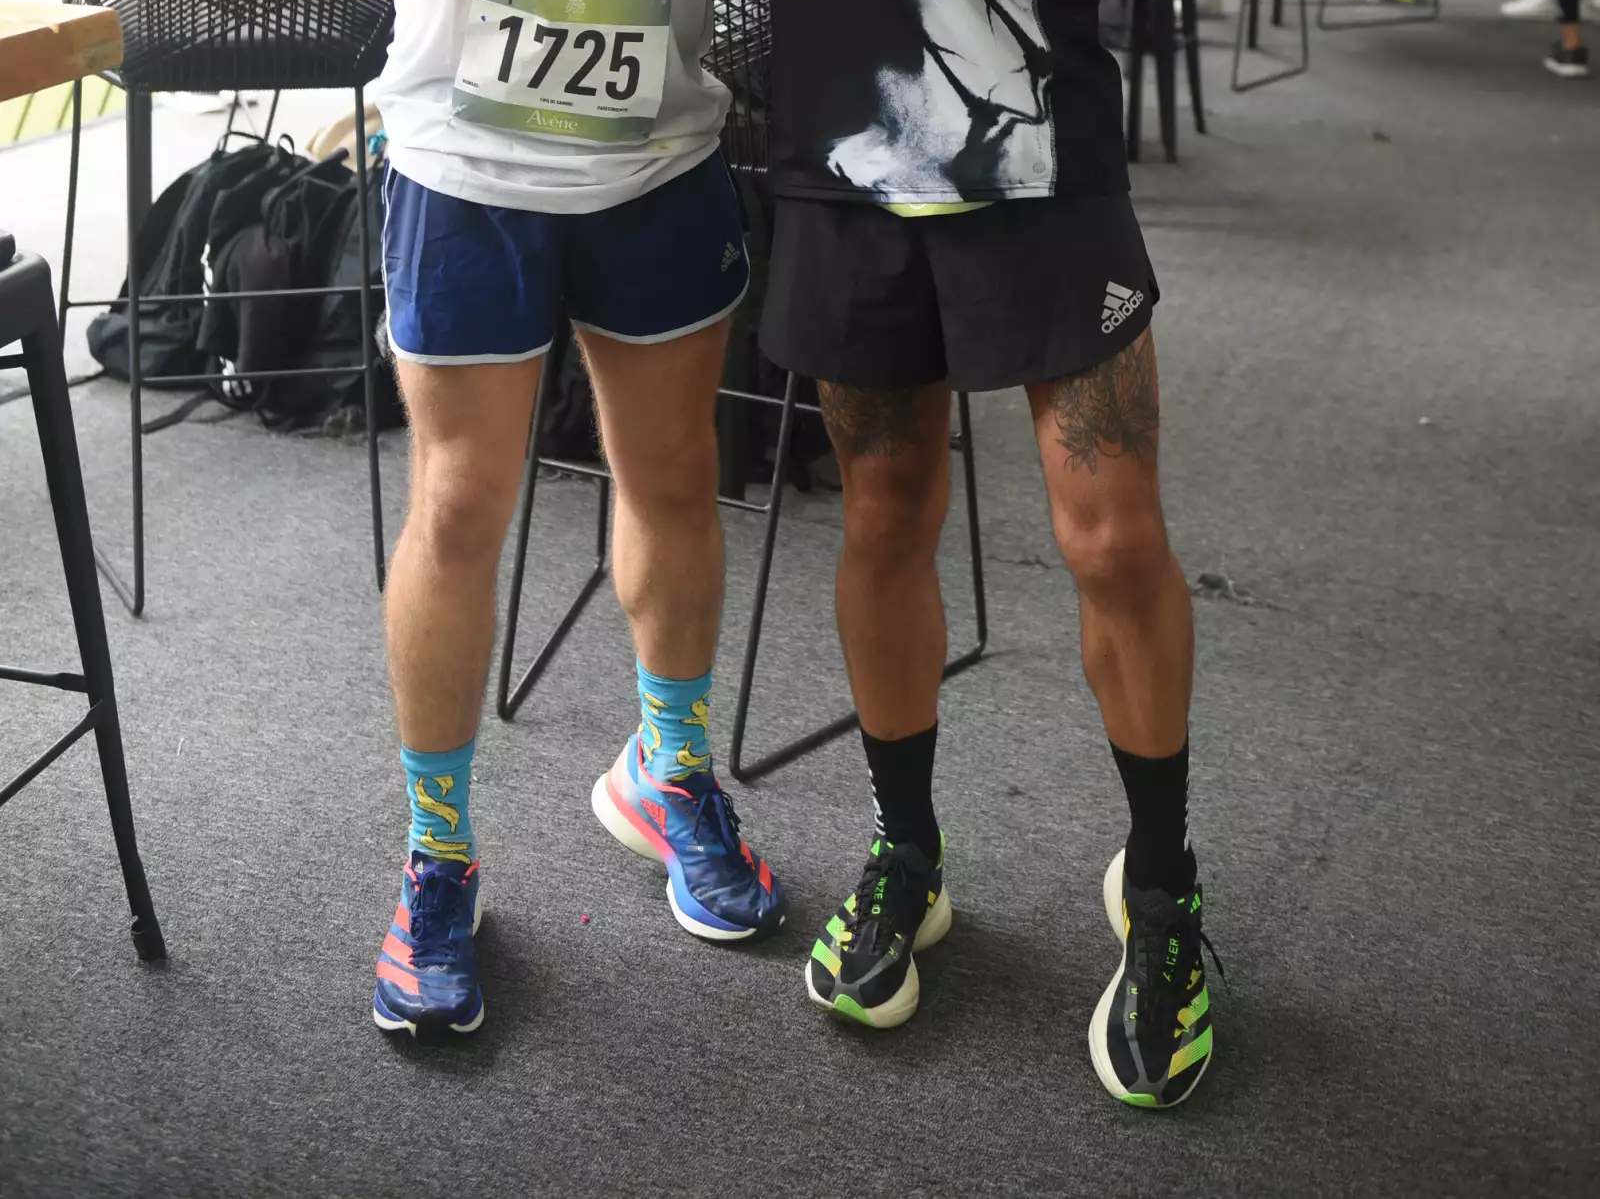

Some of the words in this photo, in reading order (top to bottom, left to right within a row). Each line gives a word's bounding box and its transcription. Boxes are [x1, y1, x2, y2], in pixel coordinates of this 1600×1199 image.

[497, 15, 645, 100] 1725
[526, 110, 578, 130] Avène
[1101, 290, 1144, 334] adidas
